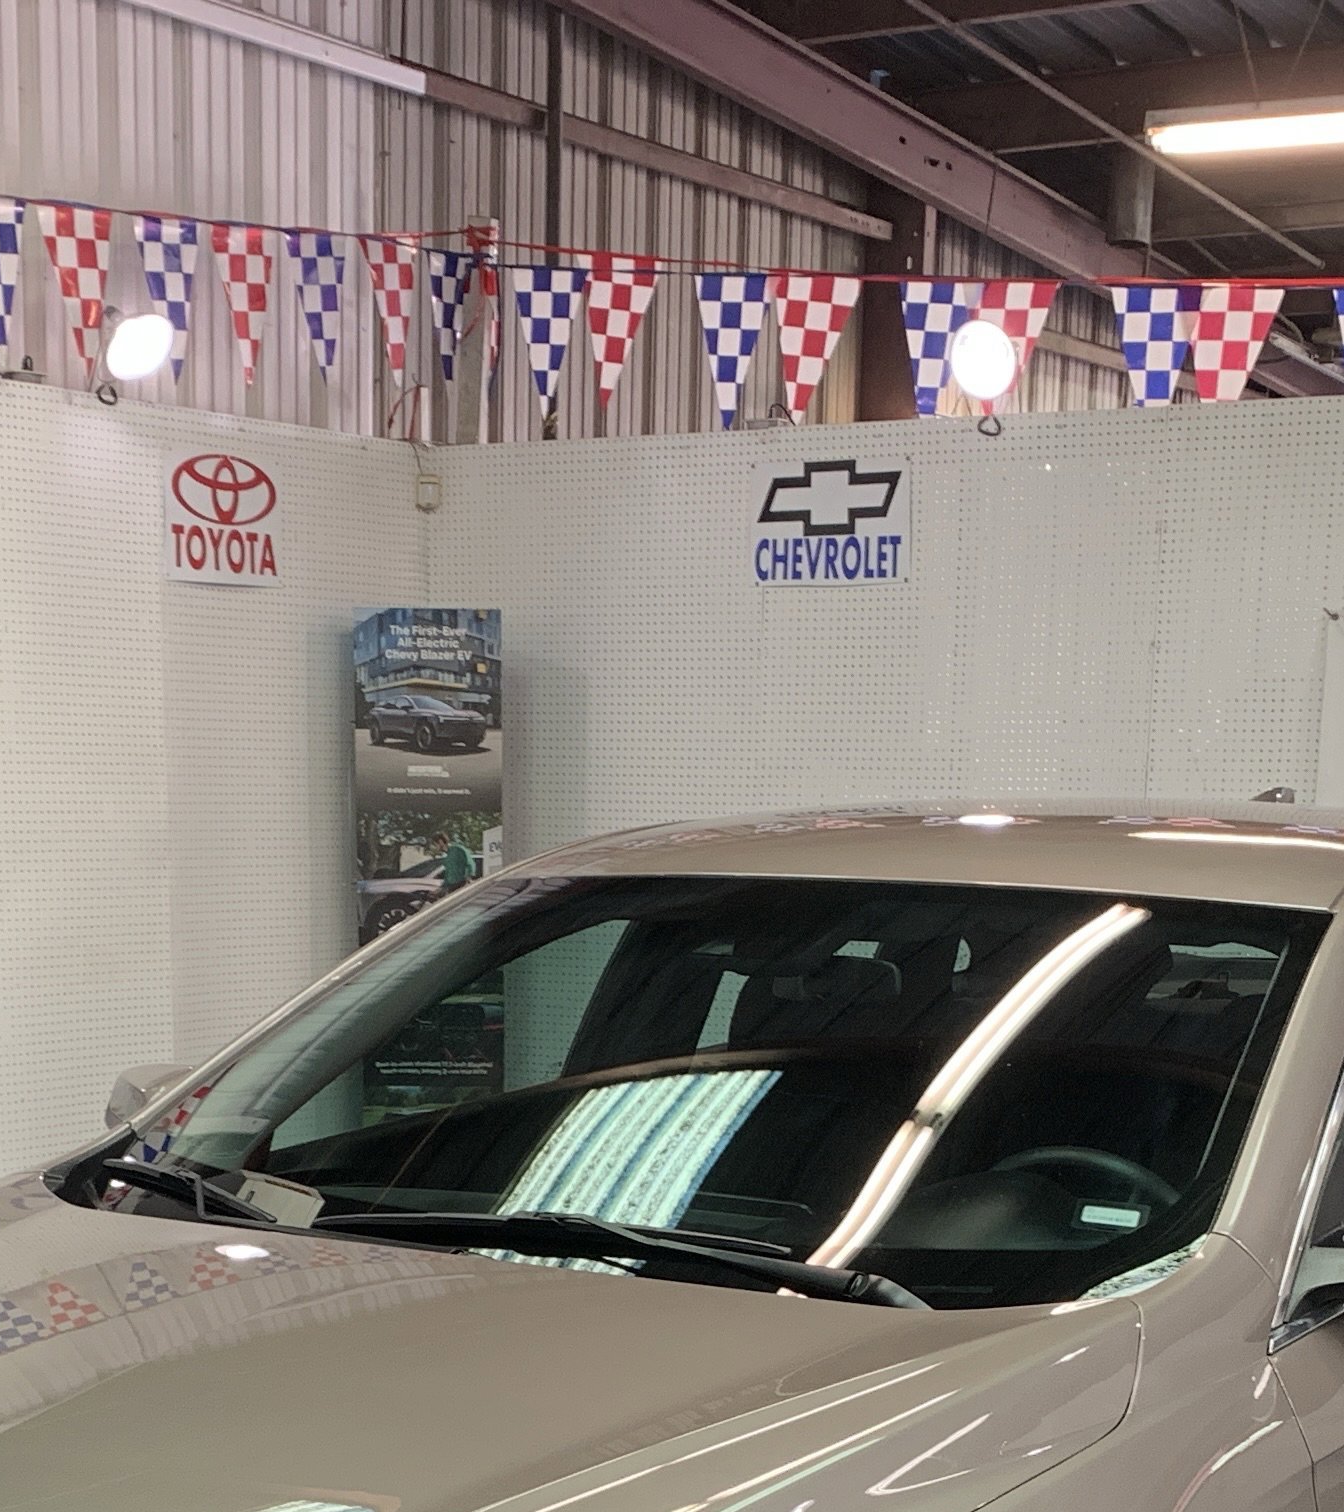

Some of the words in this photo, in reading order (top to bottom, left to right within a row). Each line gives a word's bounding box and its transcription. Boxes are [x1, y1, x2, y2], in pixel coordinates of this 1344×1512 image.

[170, 522, 278, 577] TOYOTA
[754, 534, 903, 582] CHEVROLET
[389, 624, 410, 636] The
[384, 648, 419, 662] Chevy
[420, 649, 456, 660] Blazer
[456, 649, 473, 661] EV
